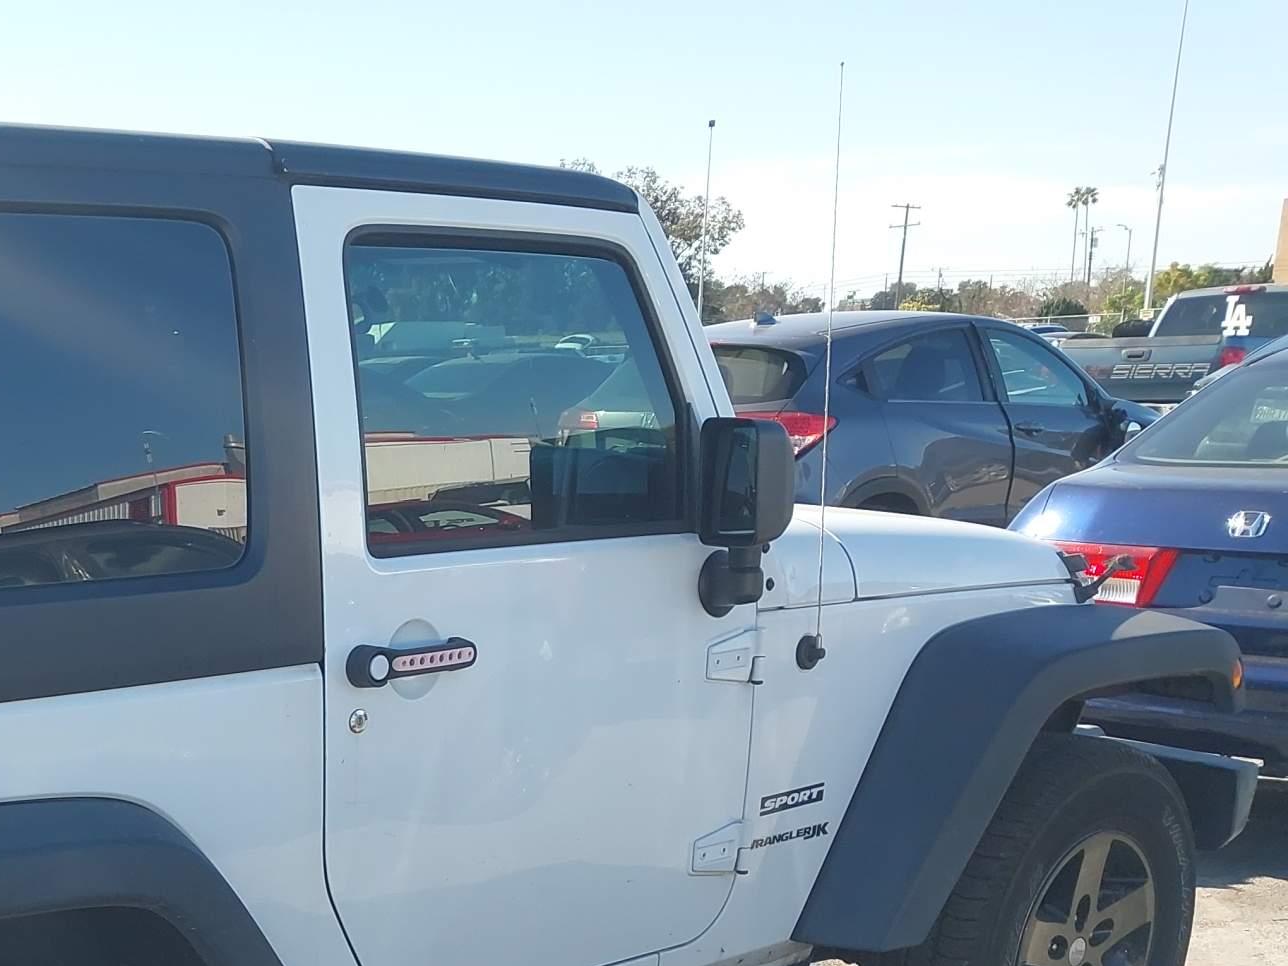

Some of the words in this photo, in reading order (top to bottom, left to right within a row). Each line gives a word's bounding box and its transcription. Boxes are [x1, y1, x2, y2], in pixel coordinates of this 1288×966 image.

[1221, 295, 1253, 337] LA
[1110, 363, 1211, 379] SIERRA
[760, 784, 824, 812] SPORT
